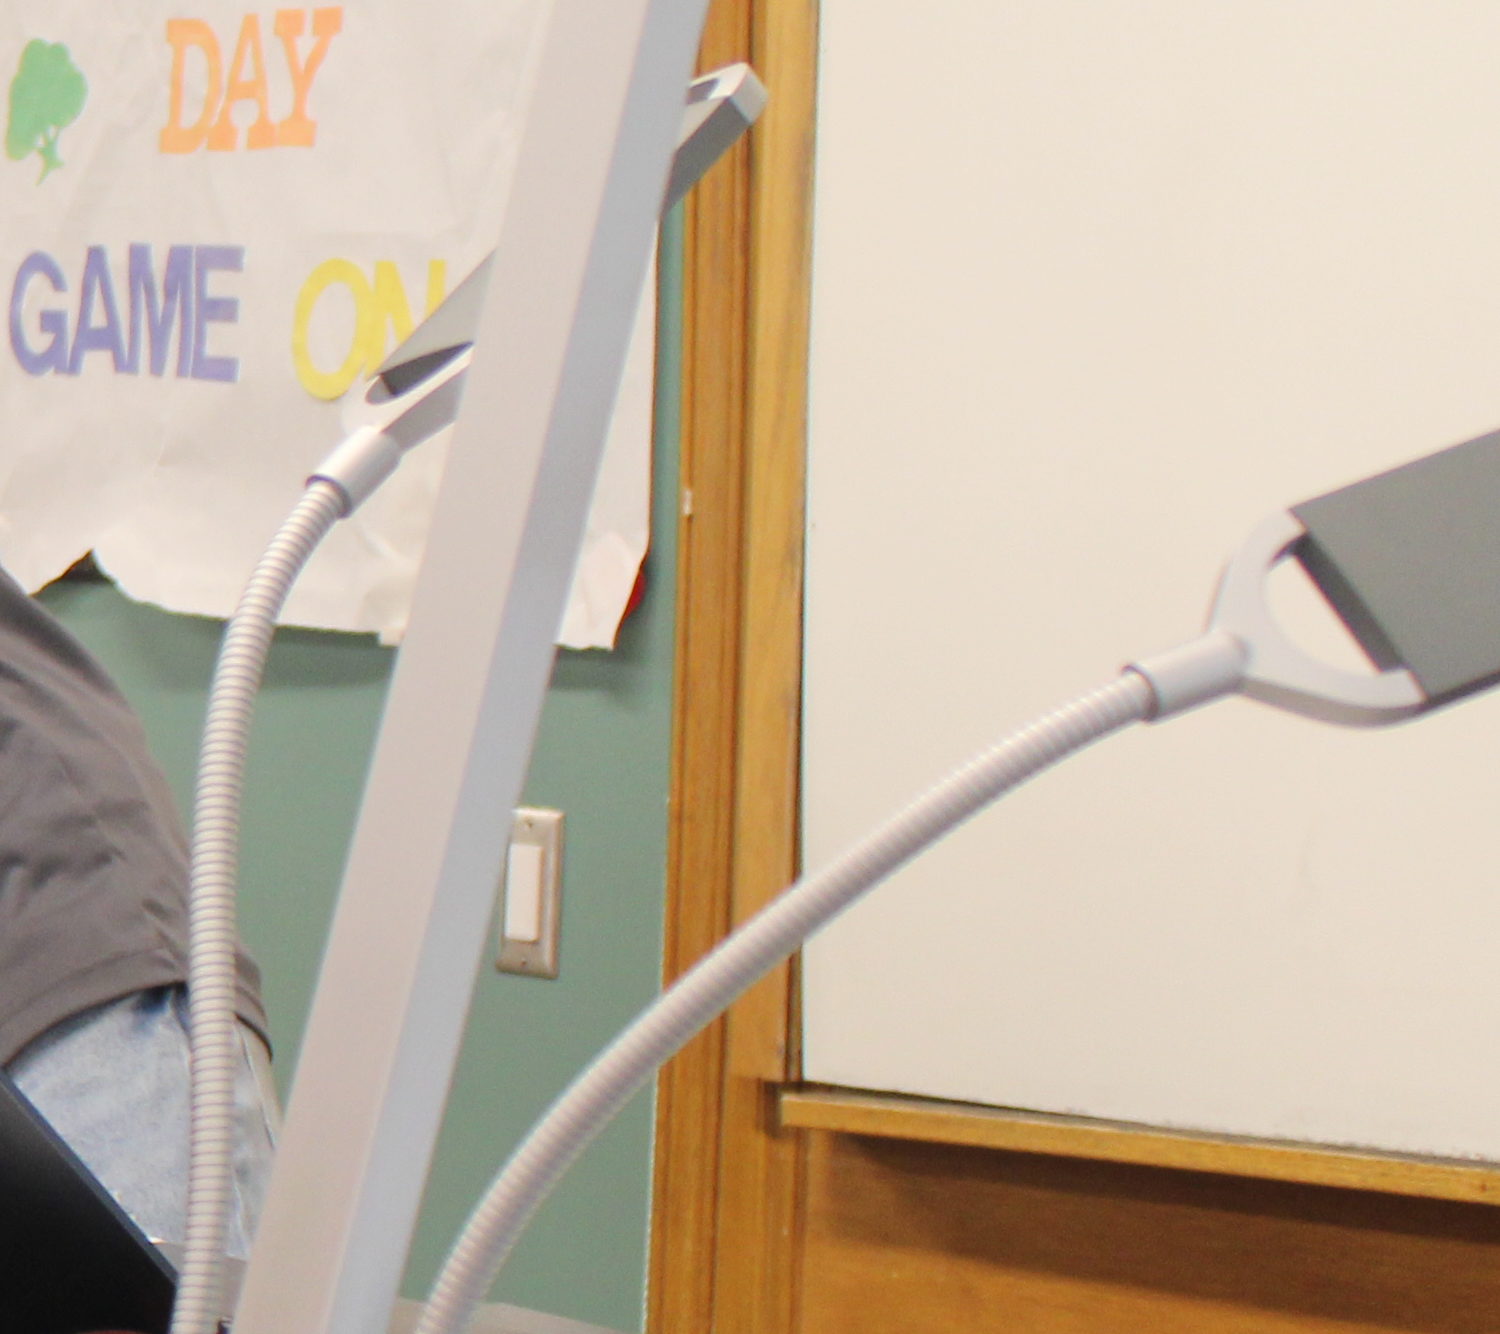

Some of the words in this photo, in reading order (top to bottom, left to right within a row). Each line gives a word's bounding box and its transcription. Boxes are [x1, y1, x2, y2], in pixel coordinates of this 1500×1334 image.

[158, 6, 343, 155] DAY
[7, 242, 246, 383] GAME
[291, 258, 446, 401] ON
